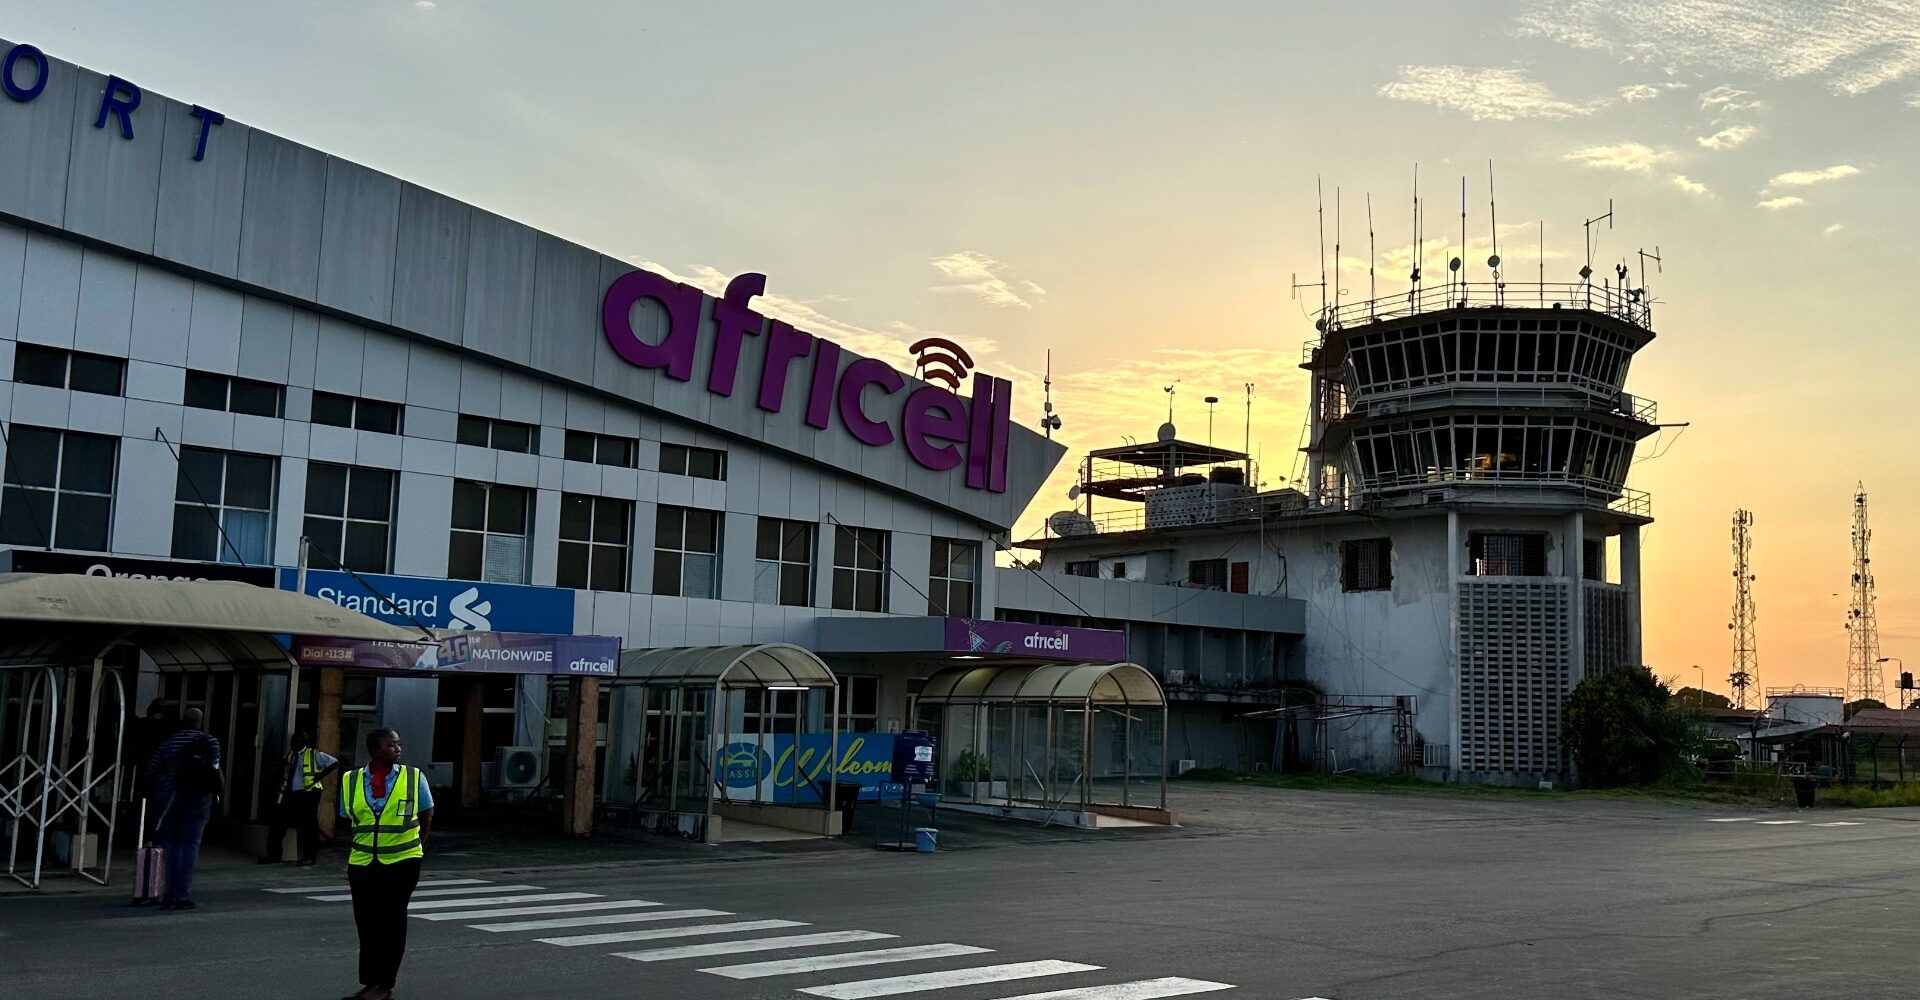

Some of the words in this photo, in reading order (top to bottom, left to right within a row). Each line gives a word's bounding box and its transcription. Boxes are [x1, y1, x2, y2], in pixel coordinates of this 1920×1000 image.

[2, 43, 225, 162] ORT
[602, 272, 1012, 494] africell
[317, 587, 438, 618] Standard
[438, 637, 469, 660] 4G
[1024, 631, 1069, 651] africell
[303, 647, 324, 659] Dial
[472, 648, 553, 662] NATIONWIDE
[569, 657, 615, 673] africell
[774, 736, 892, 788] Wlcom
[729, 769, 756, 779] ASSI
